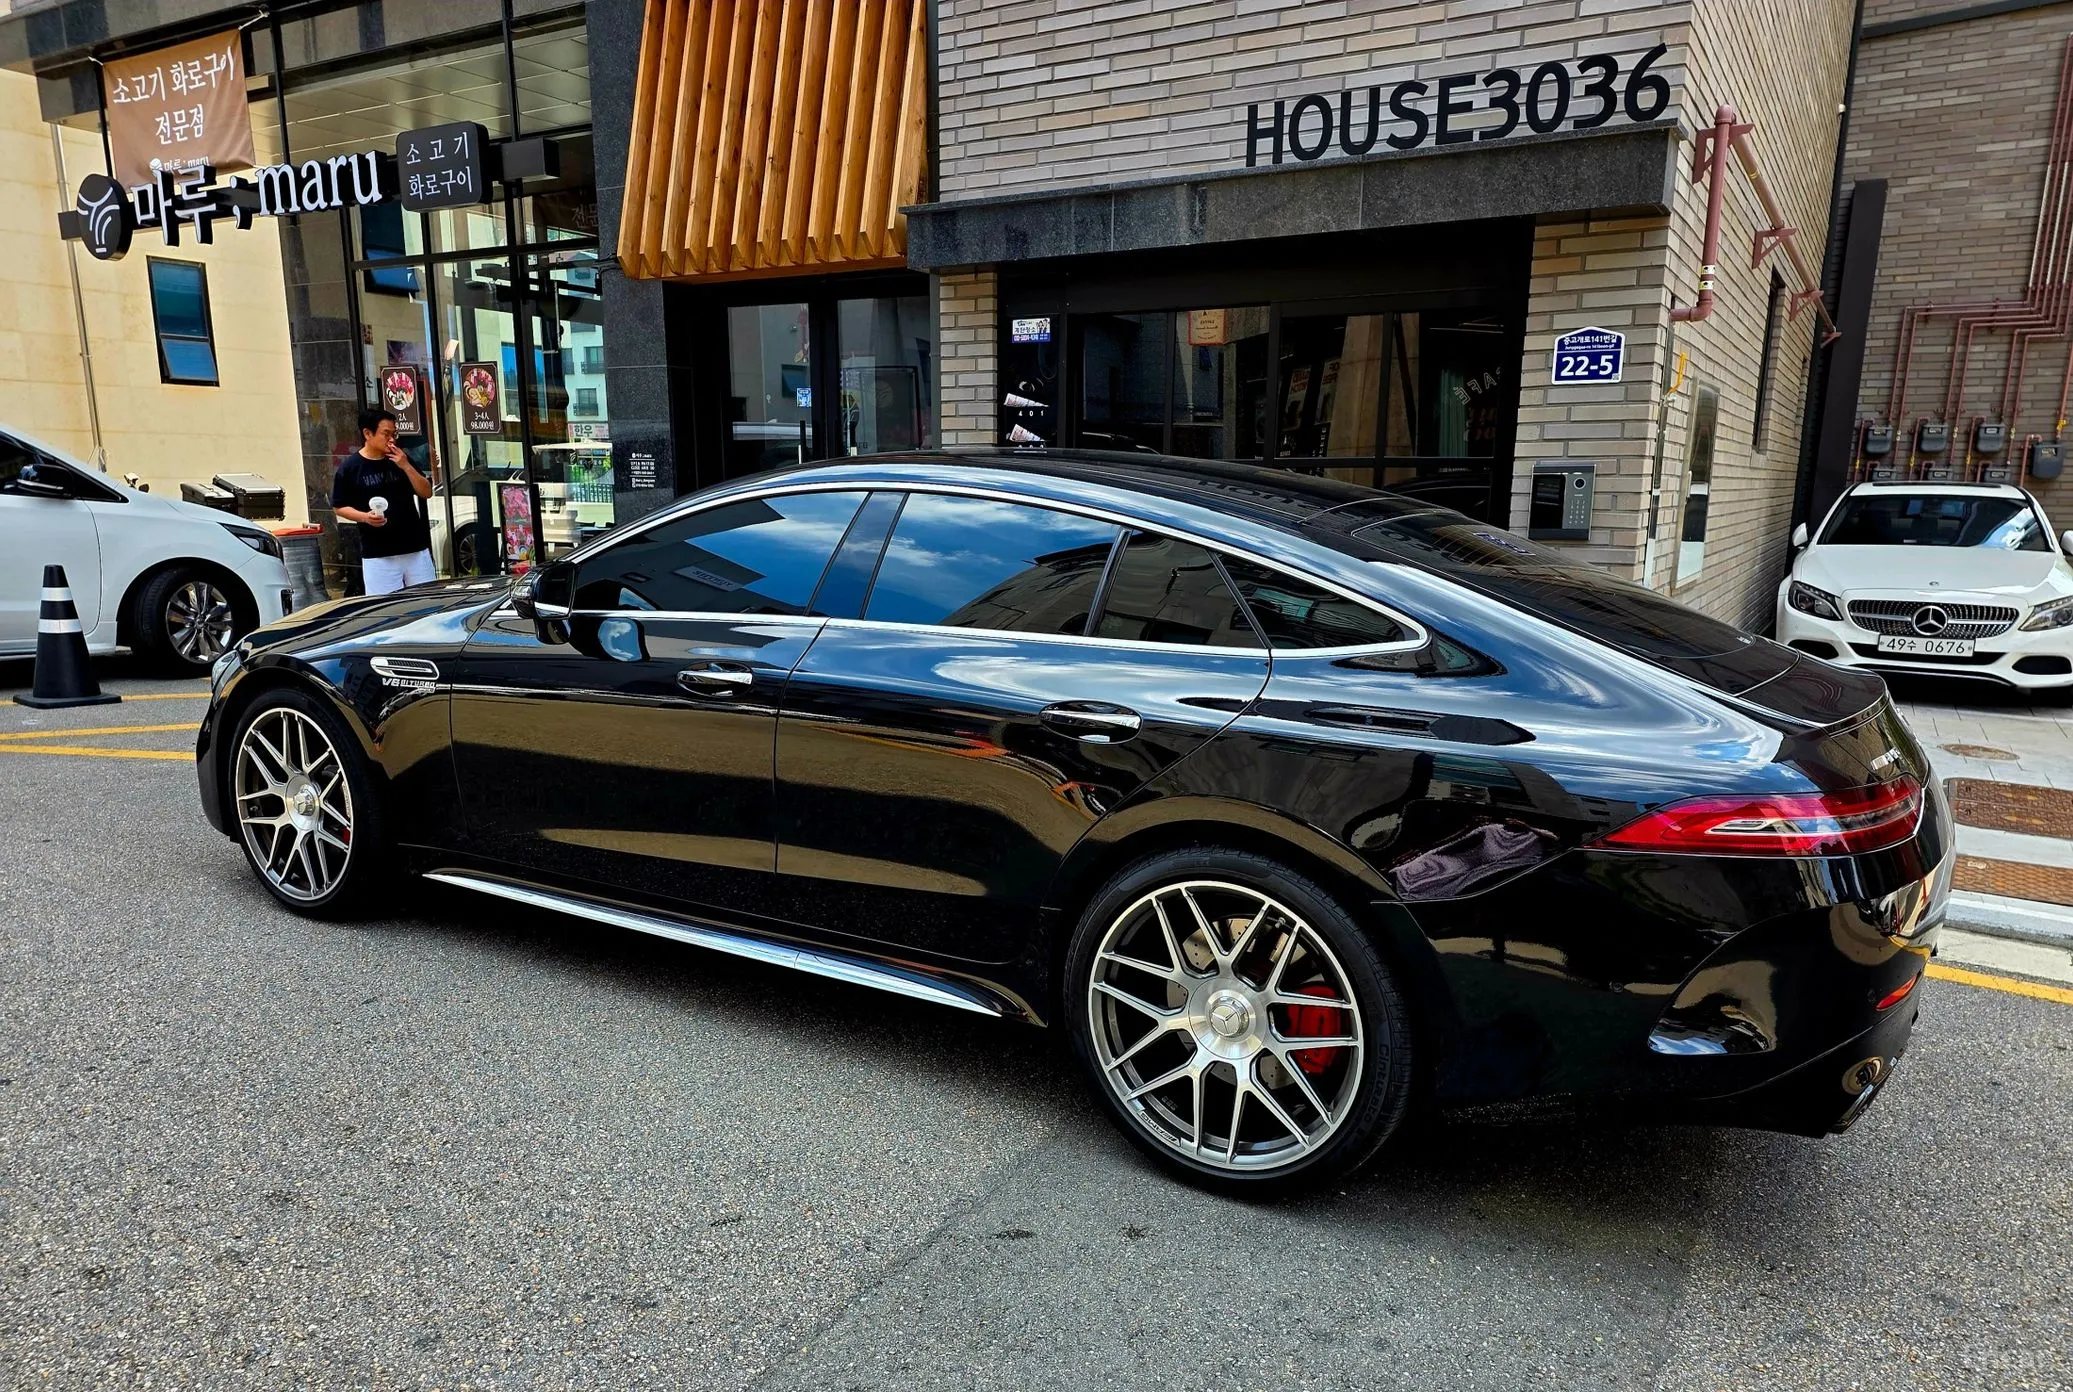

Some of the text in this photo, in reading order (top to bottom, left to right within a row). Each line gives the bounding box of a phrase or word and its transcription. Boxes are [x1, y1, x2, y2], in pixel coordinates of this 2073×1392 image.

[113, 45, 235, 103] 소고기 화로구이
[1246, 43, 1671, 167] HOUSE3036
[155, 103, 204, 145] 전문점
[409, 166, 472, 200] 화로구이
[1563, 334, 1618, 346] 중고개로141번길
[1560, 355, 1614, 377] 22-5
[574, 424, 593, 437] 한우
[1886, 638, 1965, 654] 49수 0676
